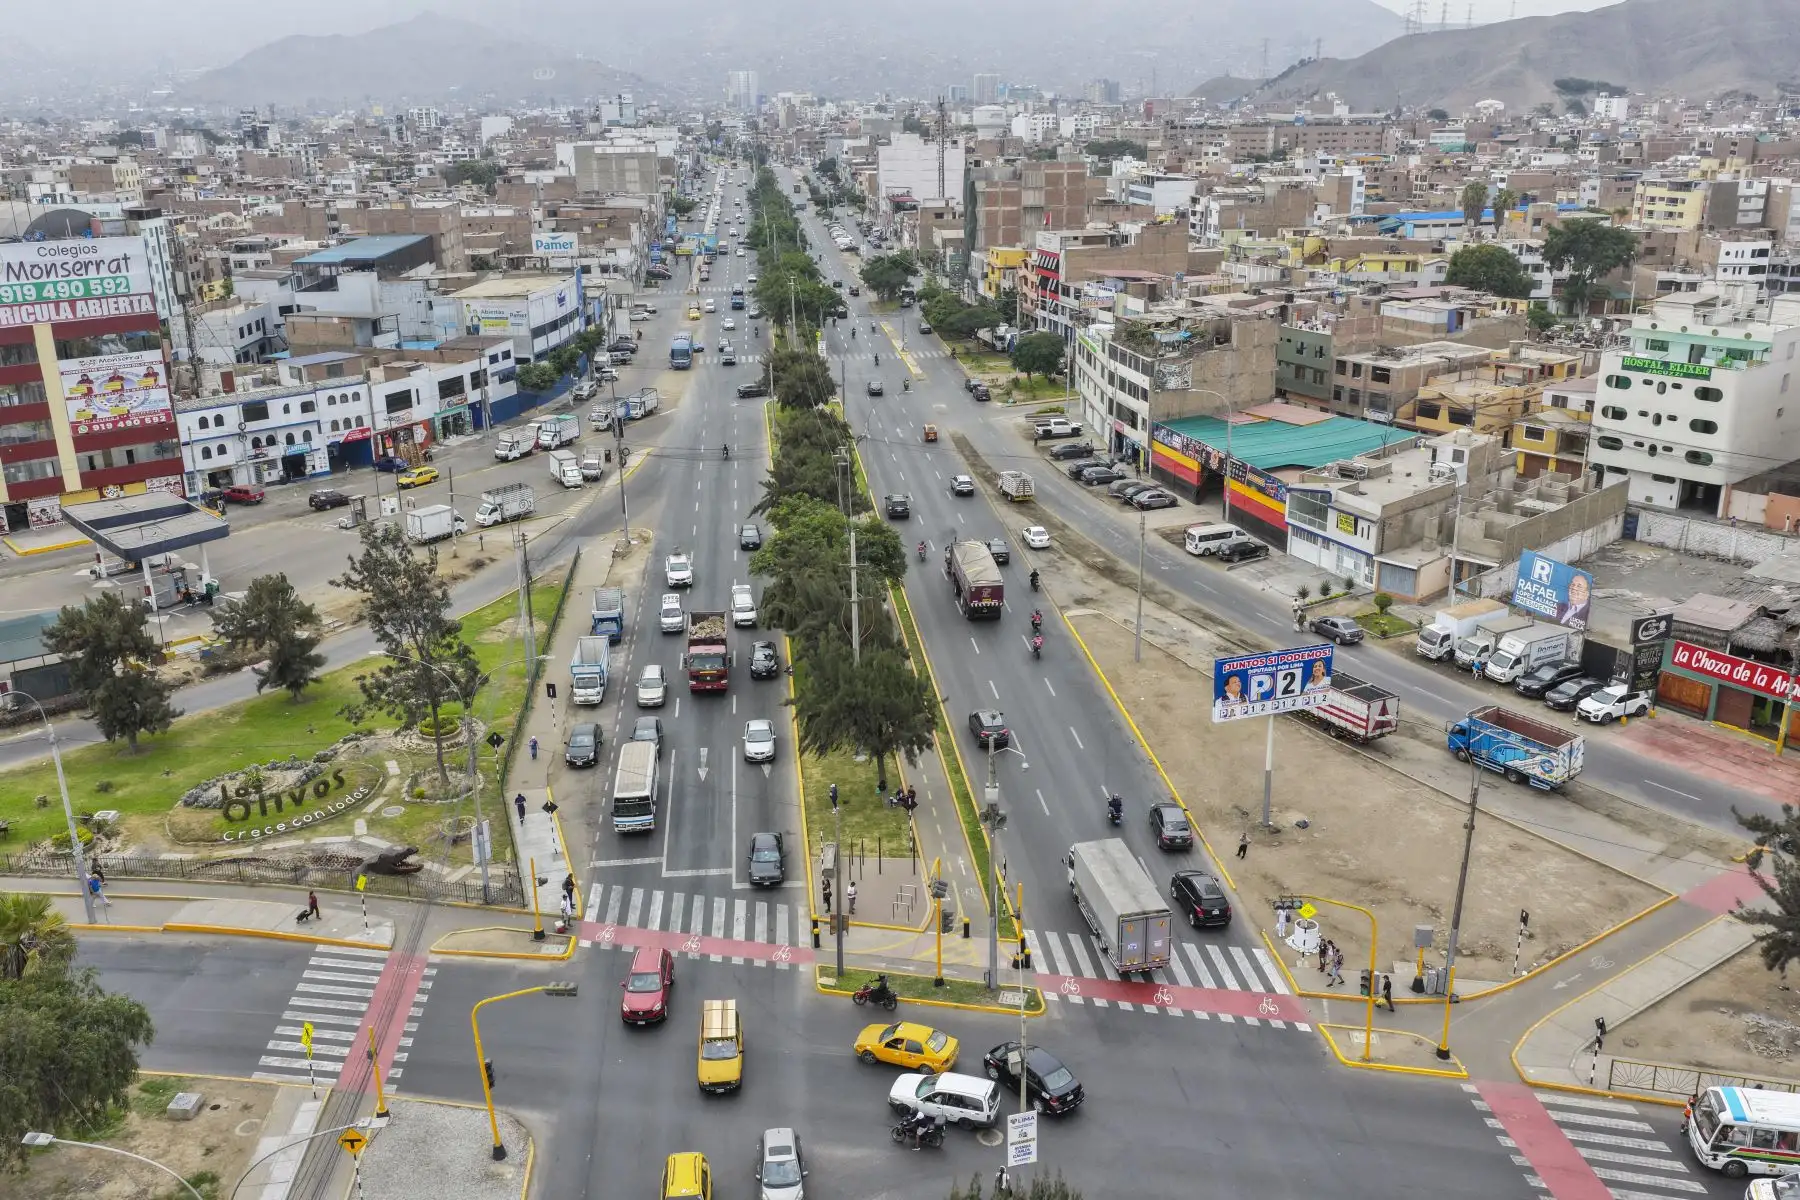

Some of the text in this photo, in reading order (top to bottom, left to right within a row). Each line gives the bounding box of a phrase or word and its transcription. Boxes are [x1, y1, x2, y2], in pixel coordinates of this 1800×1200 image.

[37, 244, 98, 258] Colegios
[536, 240, 574, 250] Pamer
[6, 253, 130, 282] Monserrat
[0, 277, 129, 303] 919 490 592
[76, 294, 154, 318] ABIERTA
[1623, 357, 1710, 376] HOSTAL ELIXER
[1533, 559, 1551, 584] R
[1516, 588, 1558, 609] LOPEZ ALIAGA
[1518, 579, 1559, 602] RAFAEL
[1248, 666, 1277, 675] DIPUTADA
[1290, 661, 1304, 669] LIMA
[1267, 656, 1278, 666] SI
[1280, 648, 1332, 663] PODEMOS!
[1691, 650, 1731, 676] Choza
[1732, 662, 1751, 681] de
[1281, 671, 1296, 696] 2
[223, 786, 369, 841] Crece con todos
[1018, 1115, 1035, 1123] LIMA
